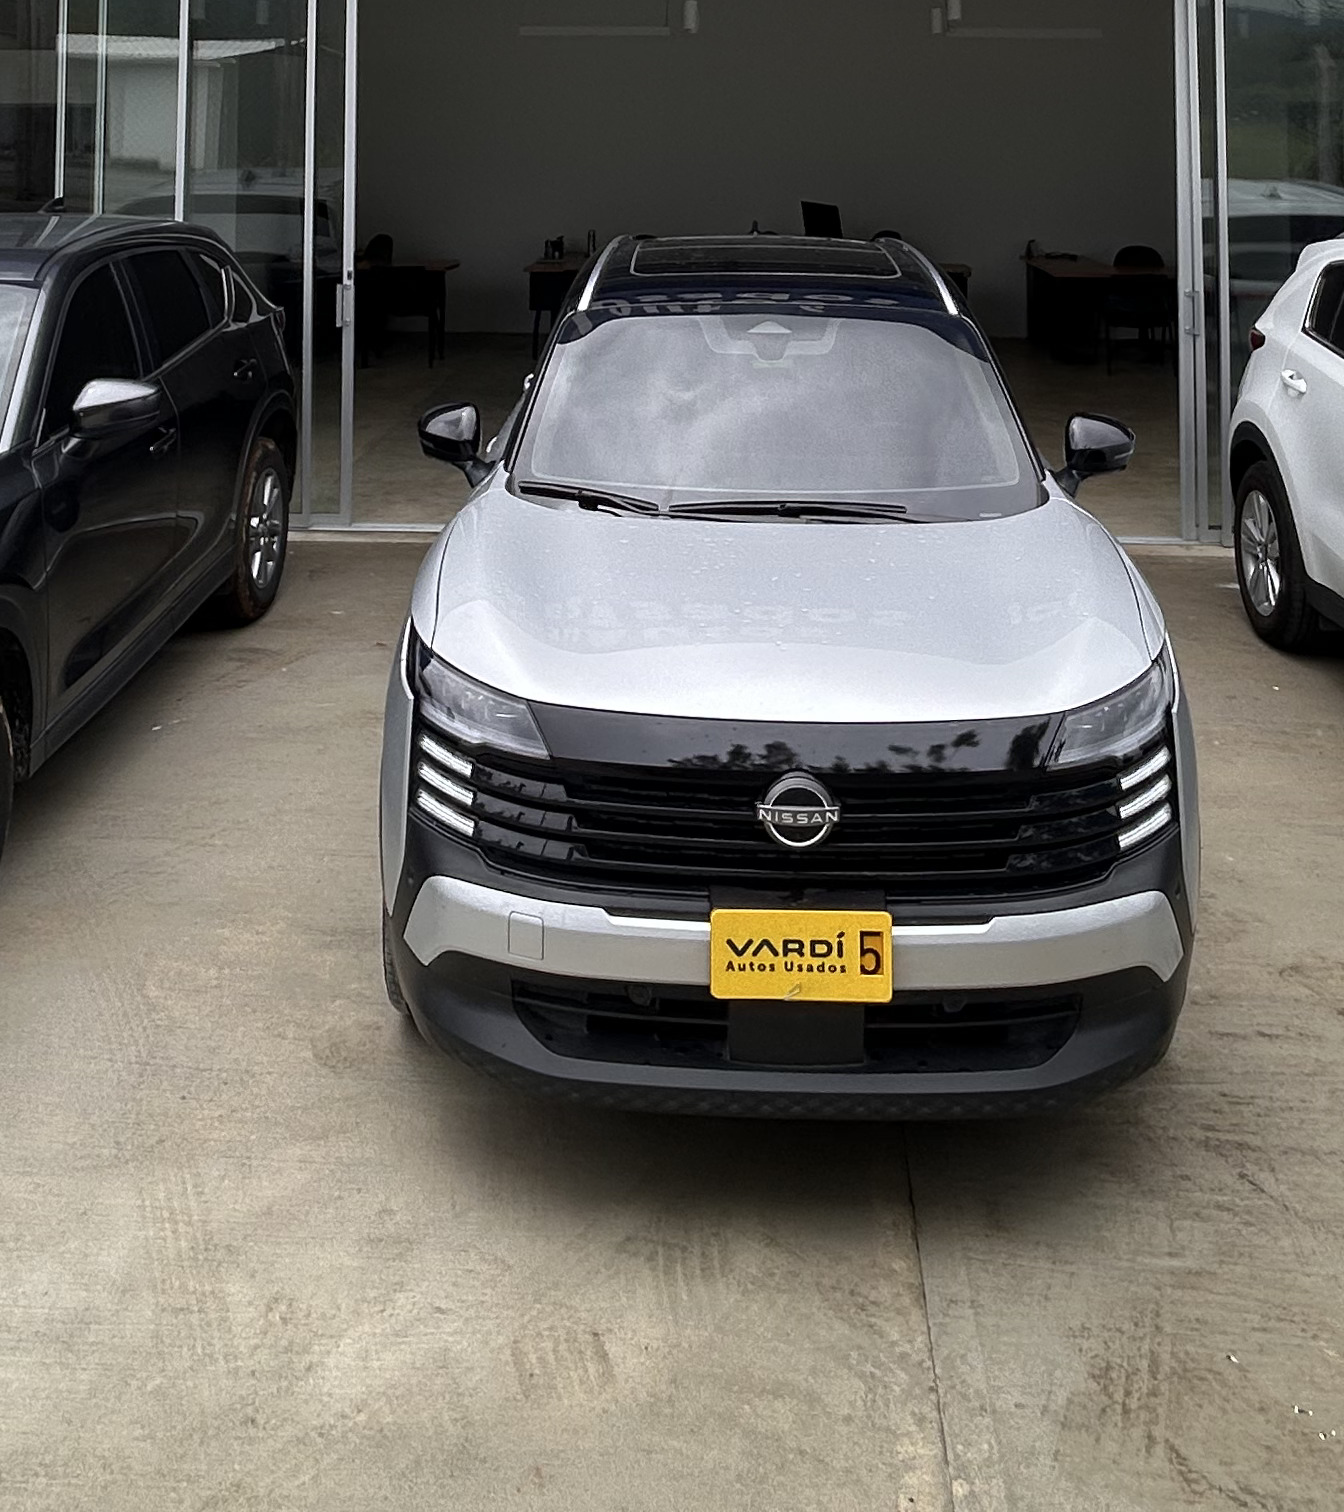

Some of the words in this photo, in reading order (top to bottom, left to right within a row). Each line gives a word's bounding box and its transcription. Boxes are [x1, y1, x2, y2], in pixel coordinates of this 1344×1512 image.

[758, 808, 839, 824] NISSAN
[725, 931, 846, 959] VARDÍ
[859, 930, 882, 976] 5
[725, 960, 776, 973] Autos
[784, 961, 847, 974] Usados
